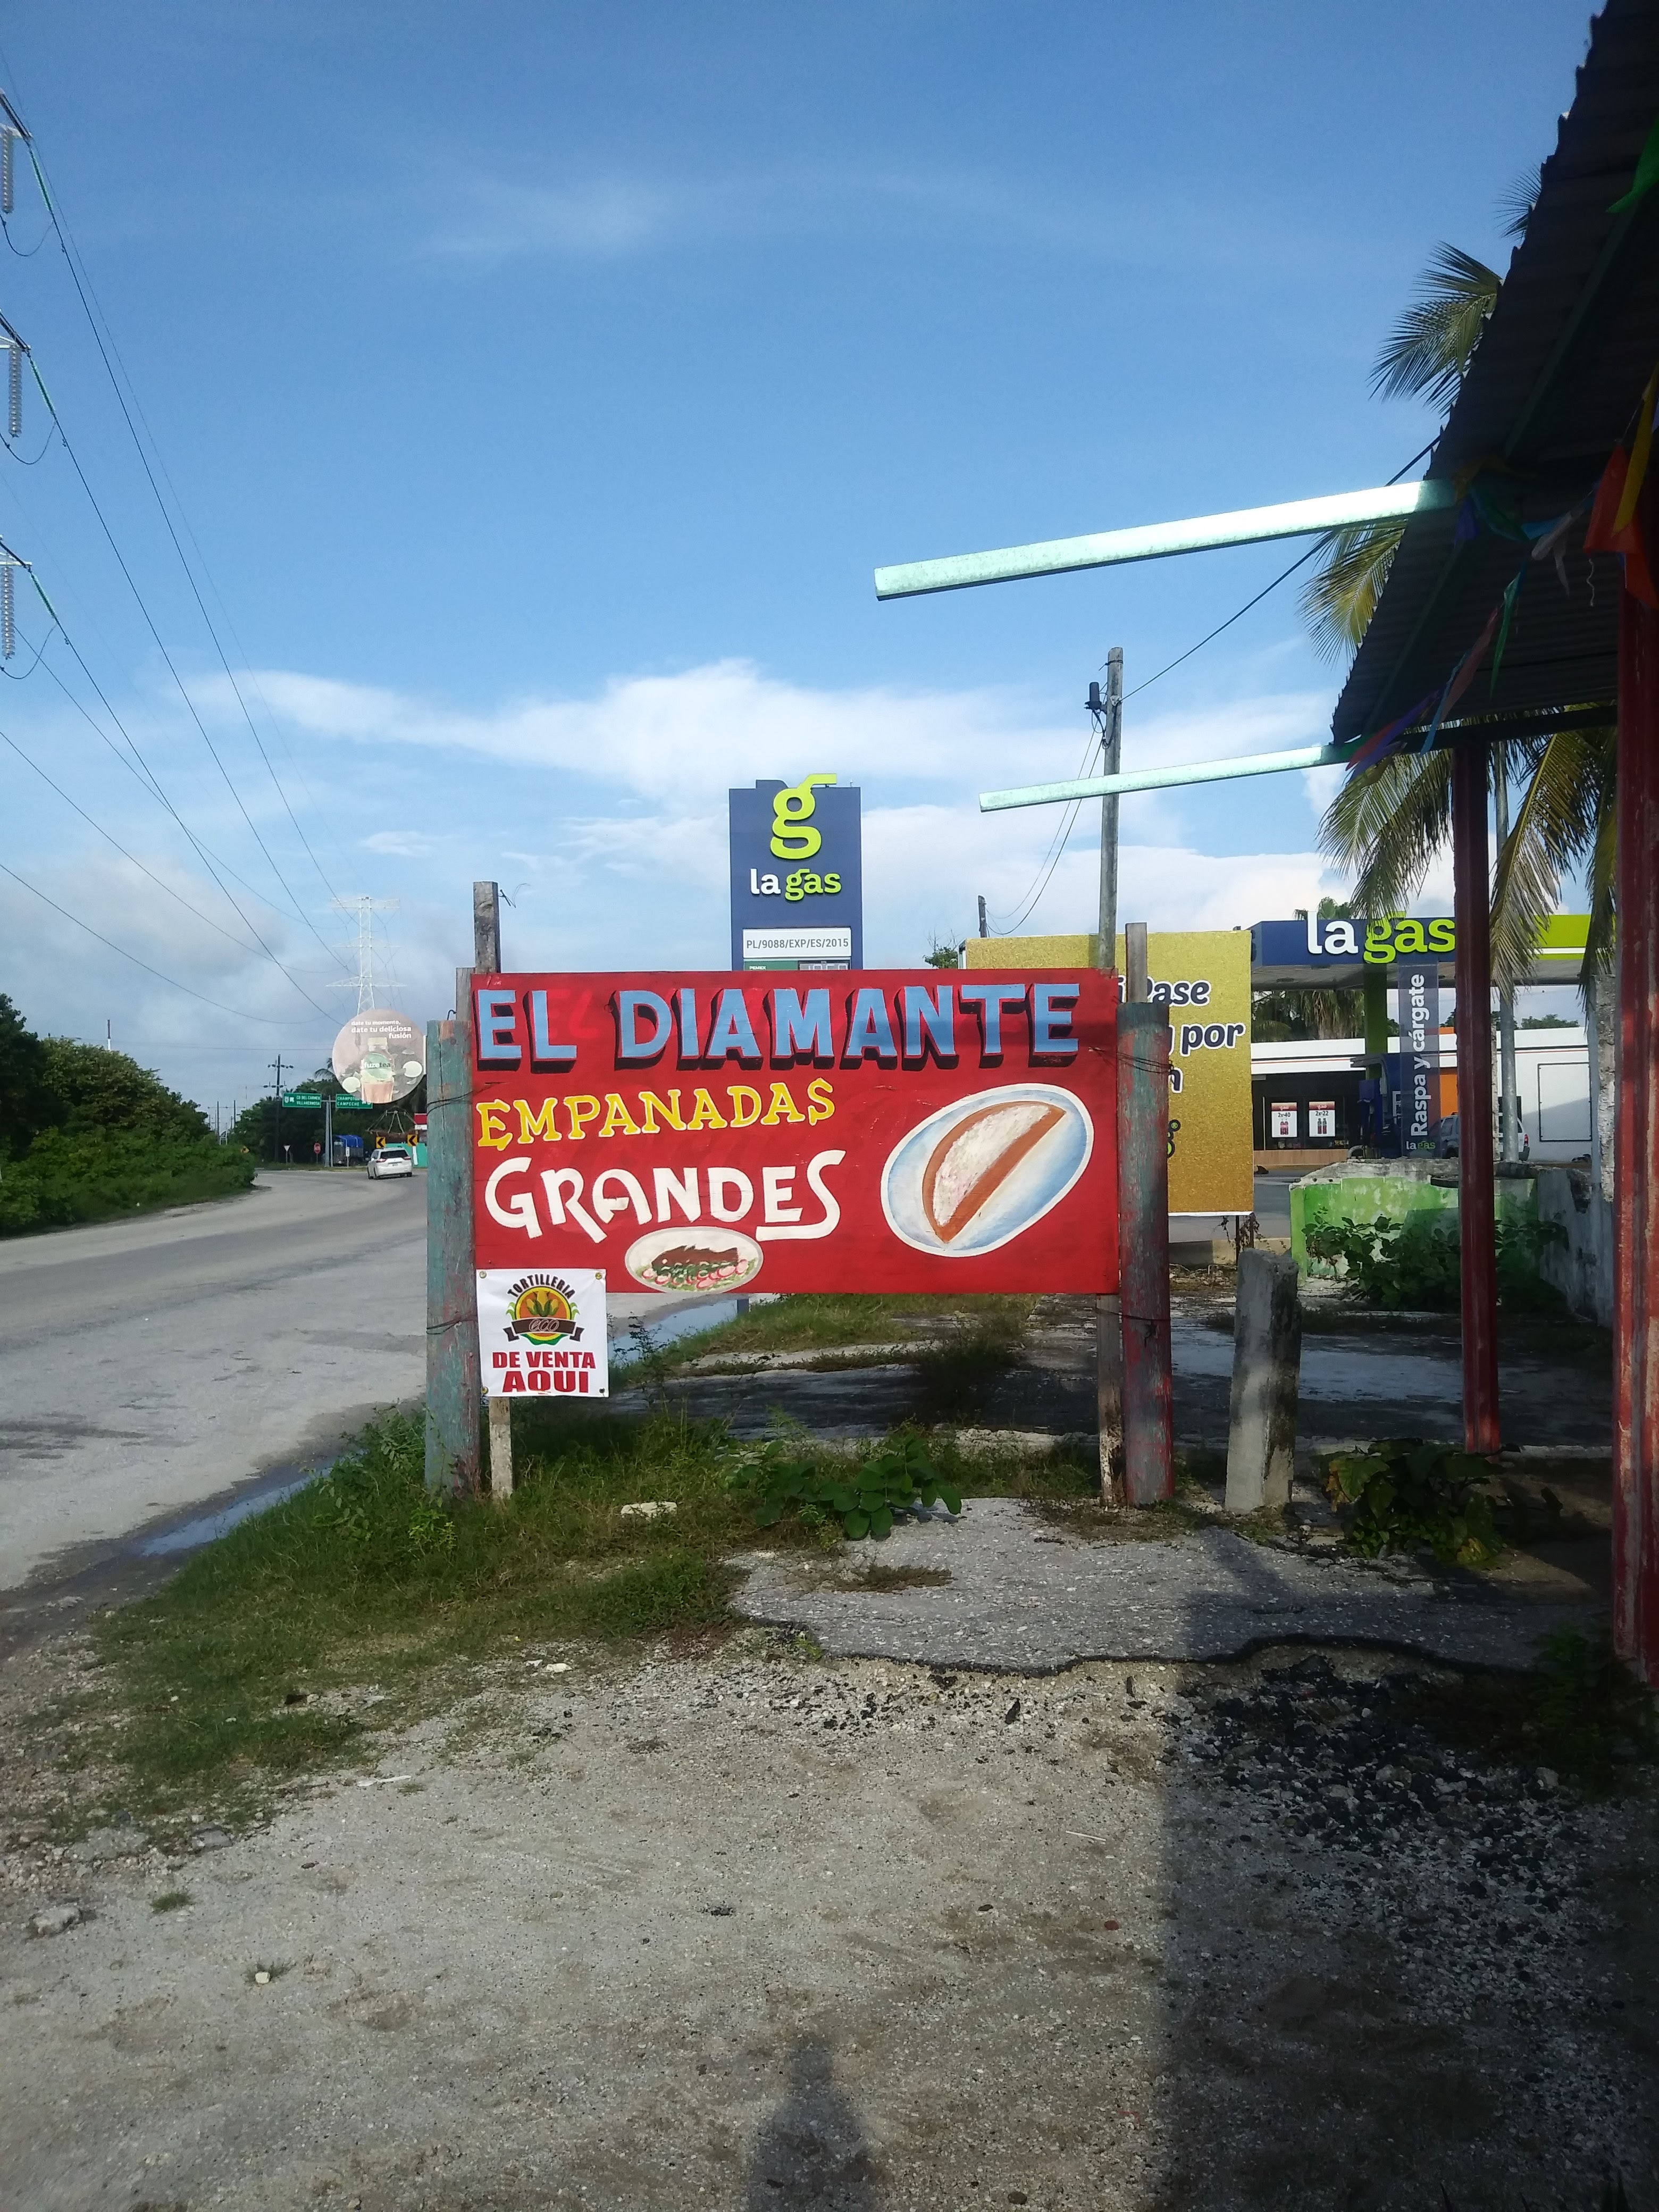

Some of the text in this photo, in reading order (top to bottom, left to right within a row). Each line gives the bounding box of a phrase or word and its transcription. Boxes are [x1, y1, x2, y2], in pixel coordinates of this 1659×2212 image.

[746, 938, 849, 949] PL/9088/EXP/ES/2015
[475, 983, 1081, 1070] EL DIAMANTE
[1181, 1024, 1245, 1055] por
[1409, 974, 1431, 1136] Raspa y cárgate
[476, 1077, 836, 1150] EMPANADAS
[485, 1150, 847, 1244] GRANDES
[507, 1273, 576, 1300] TORTILLERIA
[492, 1351, 597, 1369] DE VENTA
[502, 1370, 589, 1394] AQUI
